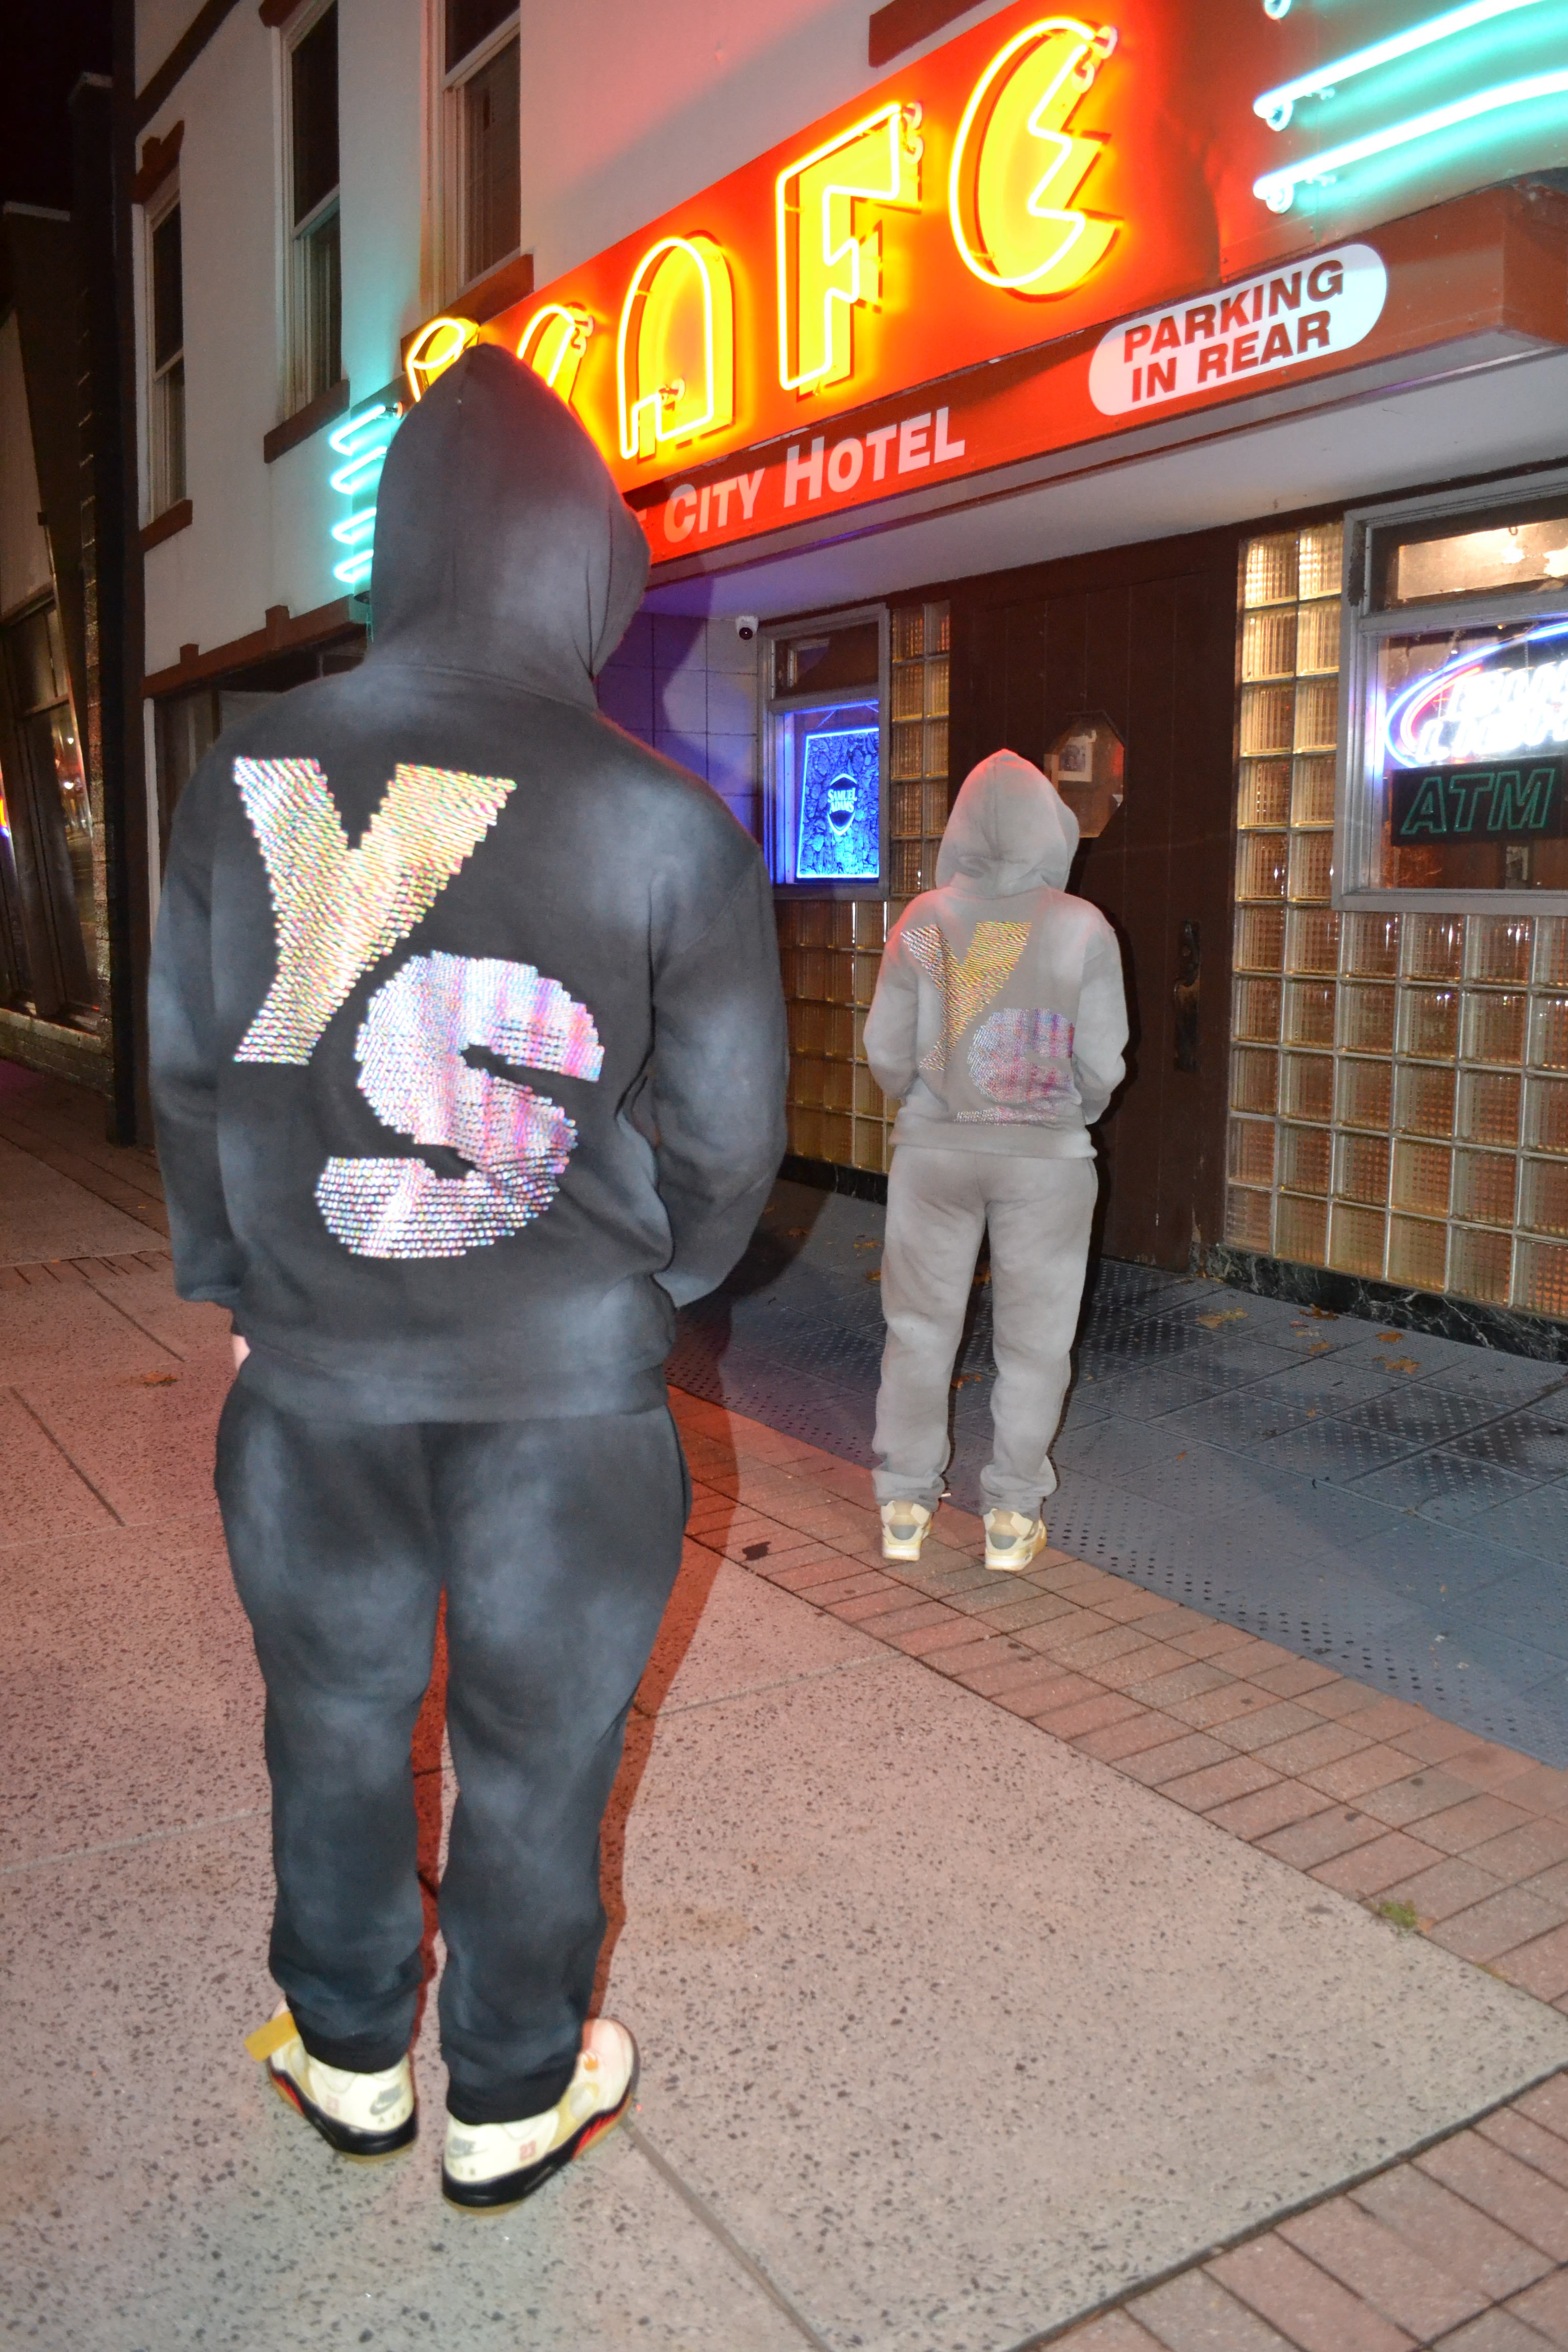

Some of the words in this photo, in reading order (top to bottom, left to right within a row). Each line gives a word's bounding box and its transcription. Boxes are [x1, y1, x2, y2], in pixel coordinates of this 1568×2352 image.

[1123, 259, 1344, 363] PARKING
[1131, 360, 1178, 404] IN
[1196, 310, 1331, 384] REAR
[663, 468, 766, 543] CITY
[783, 406, 965, 508] HOTEL
[827, 788, 857, 803] SAMUEL
[829, 800, 855, 815] ADAMS
[1400, 767, 1556, 836] ATM
